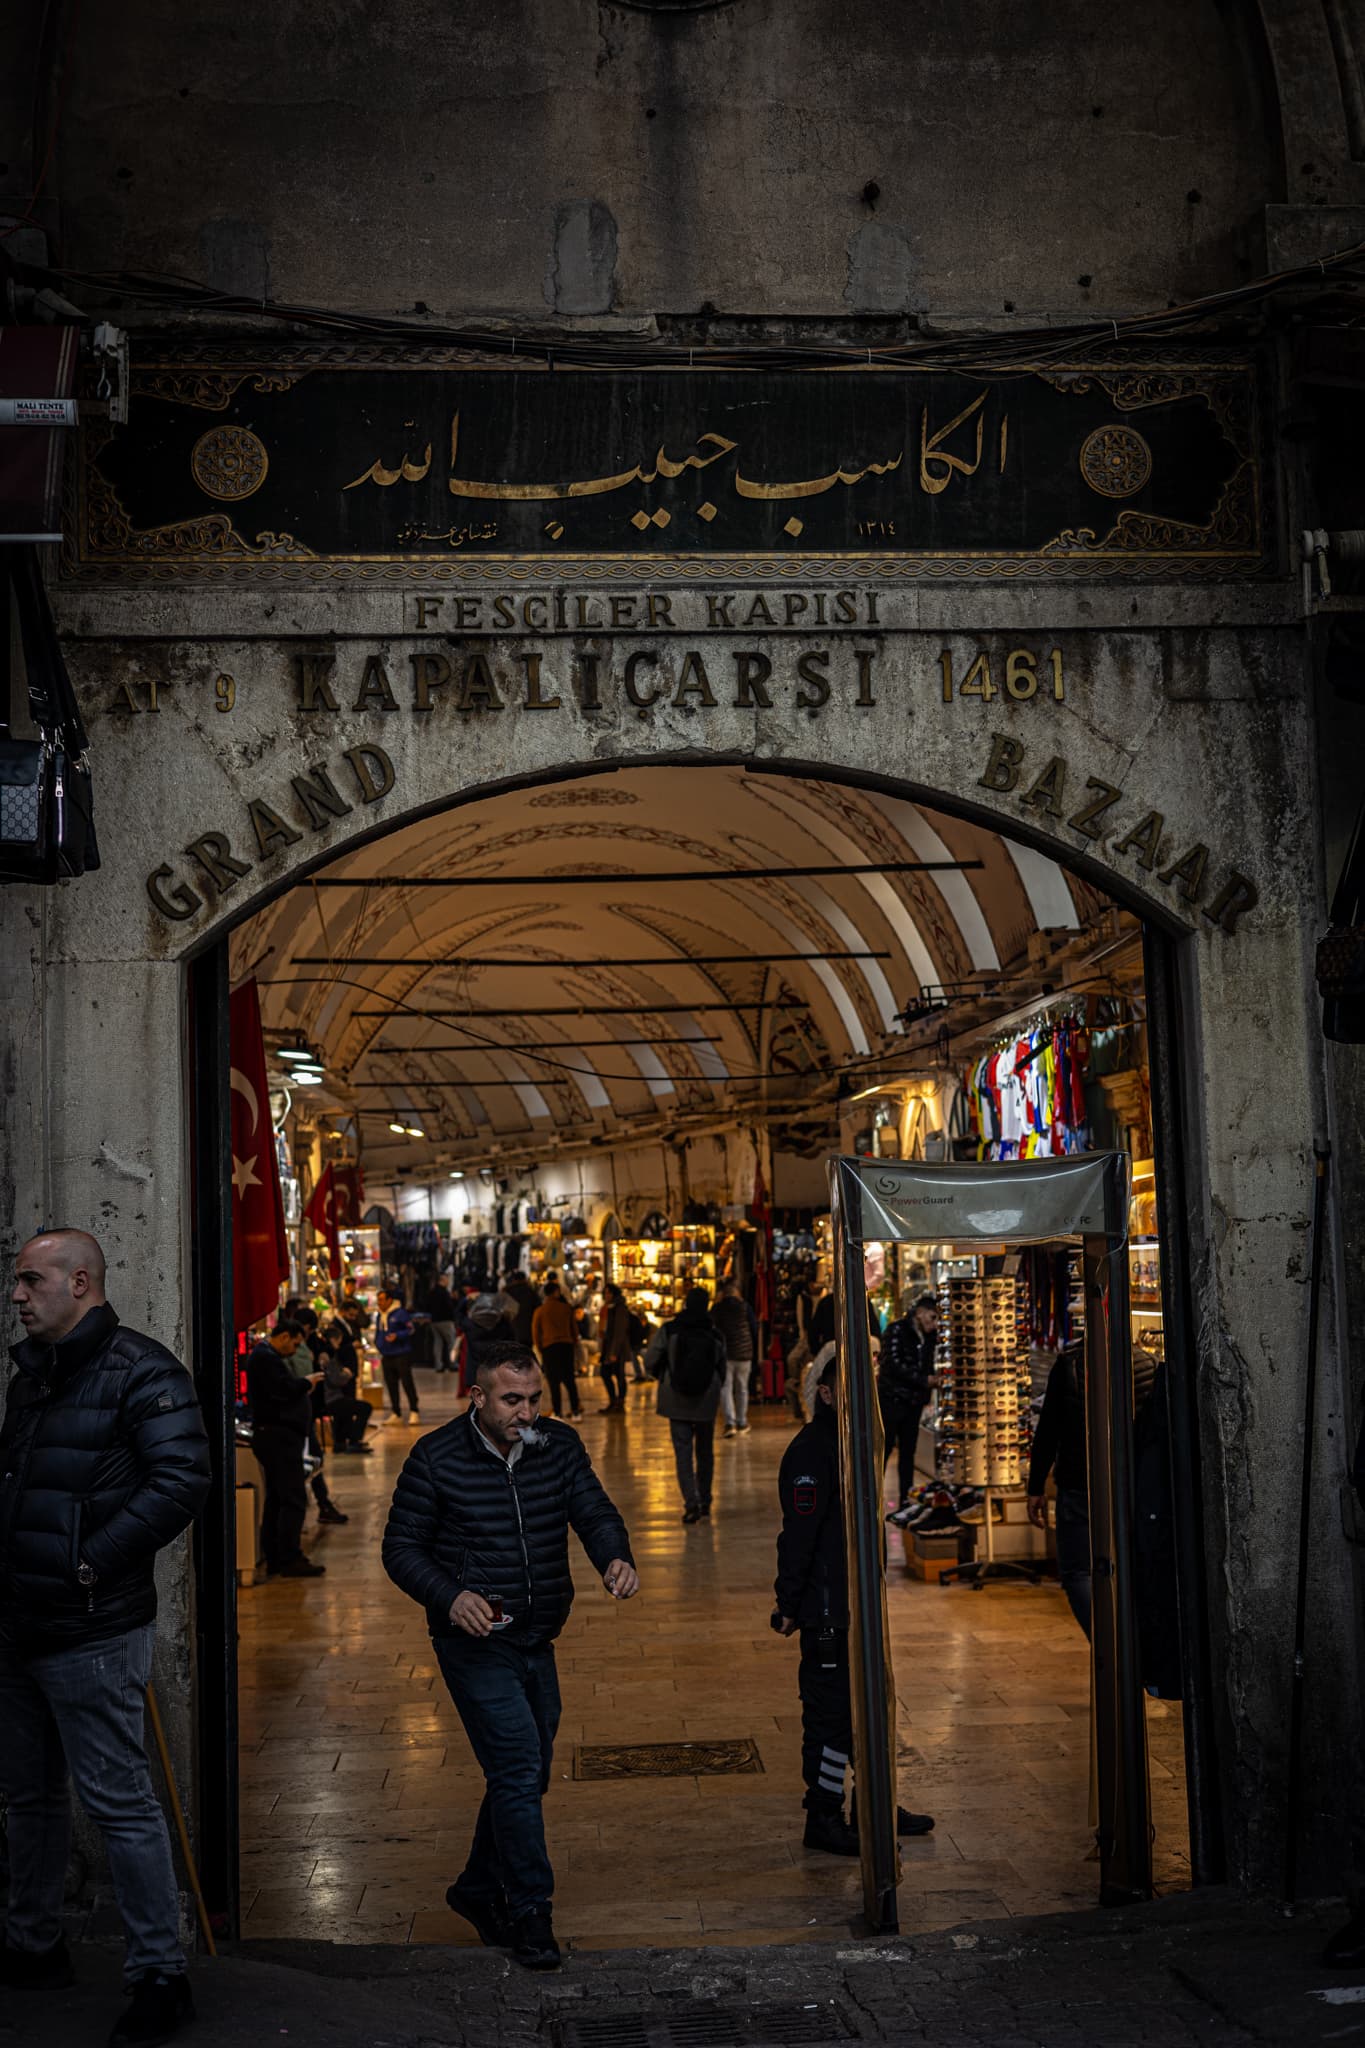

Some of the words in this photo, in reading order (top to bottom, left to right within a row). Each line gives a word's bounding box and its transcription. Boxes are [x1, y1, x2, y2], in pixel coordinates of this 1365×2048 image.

[449, 432, 738, 540] حبيب
[736, 386, 1008, 537] الكاسب
[705, 591, 880, 627] KAPISI
[215, 673, 236, 713] 9
[938, 647, 1065, 702] 1461
[146, 742, 396, 921] GRAND
[977, 733, 1258, 935] BAZAAR
[891, 1195, 953, 1205] PowerGuard
